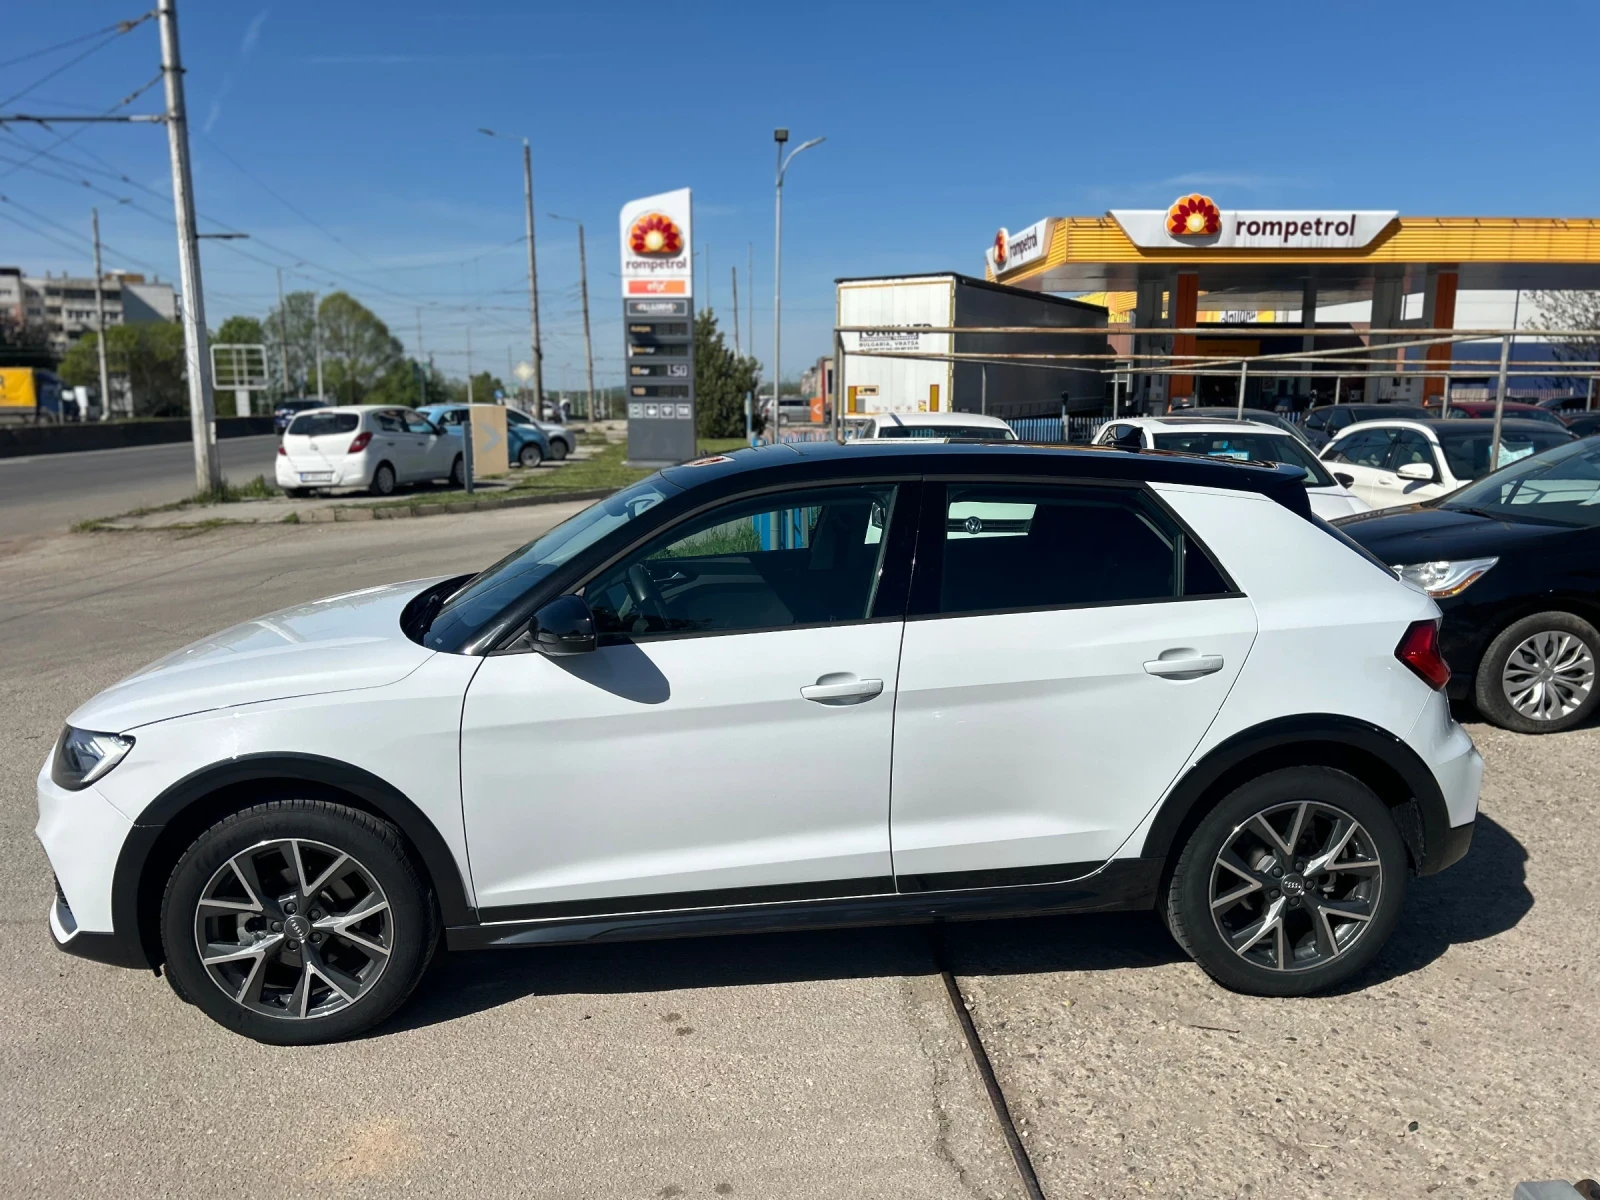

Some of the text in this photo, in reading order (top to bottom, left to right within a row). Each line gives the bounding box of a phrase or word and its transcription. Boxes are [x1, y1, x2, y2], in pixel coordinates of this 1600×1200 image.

[1009, 226, 1038, 260] rompetrol
[1235, 214, 1356, 243] rompetrol
[626, 256, 687, 272] rompetrol
